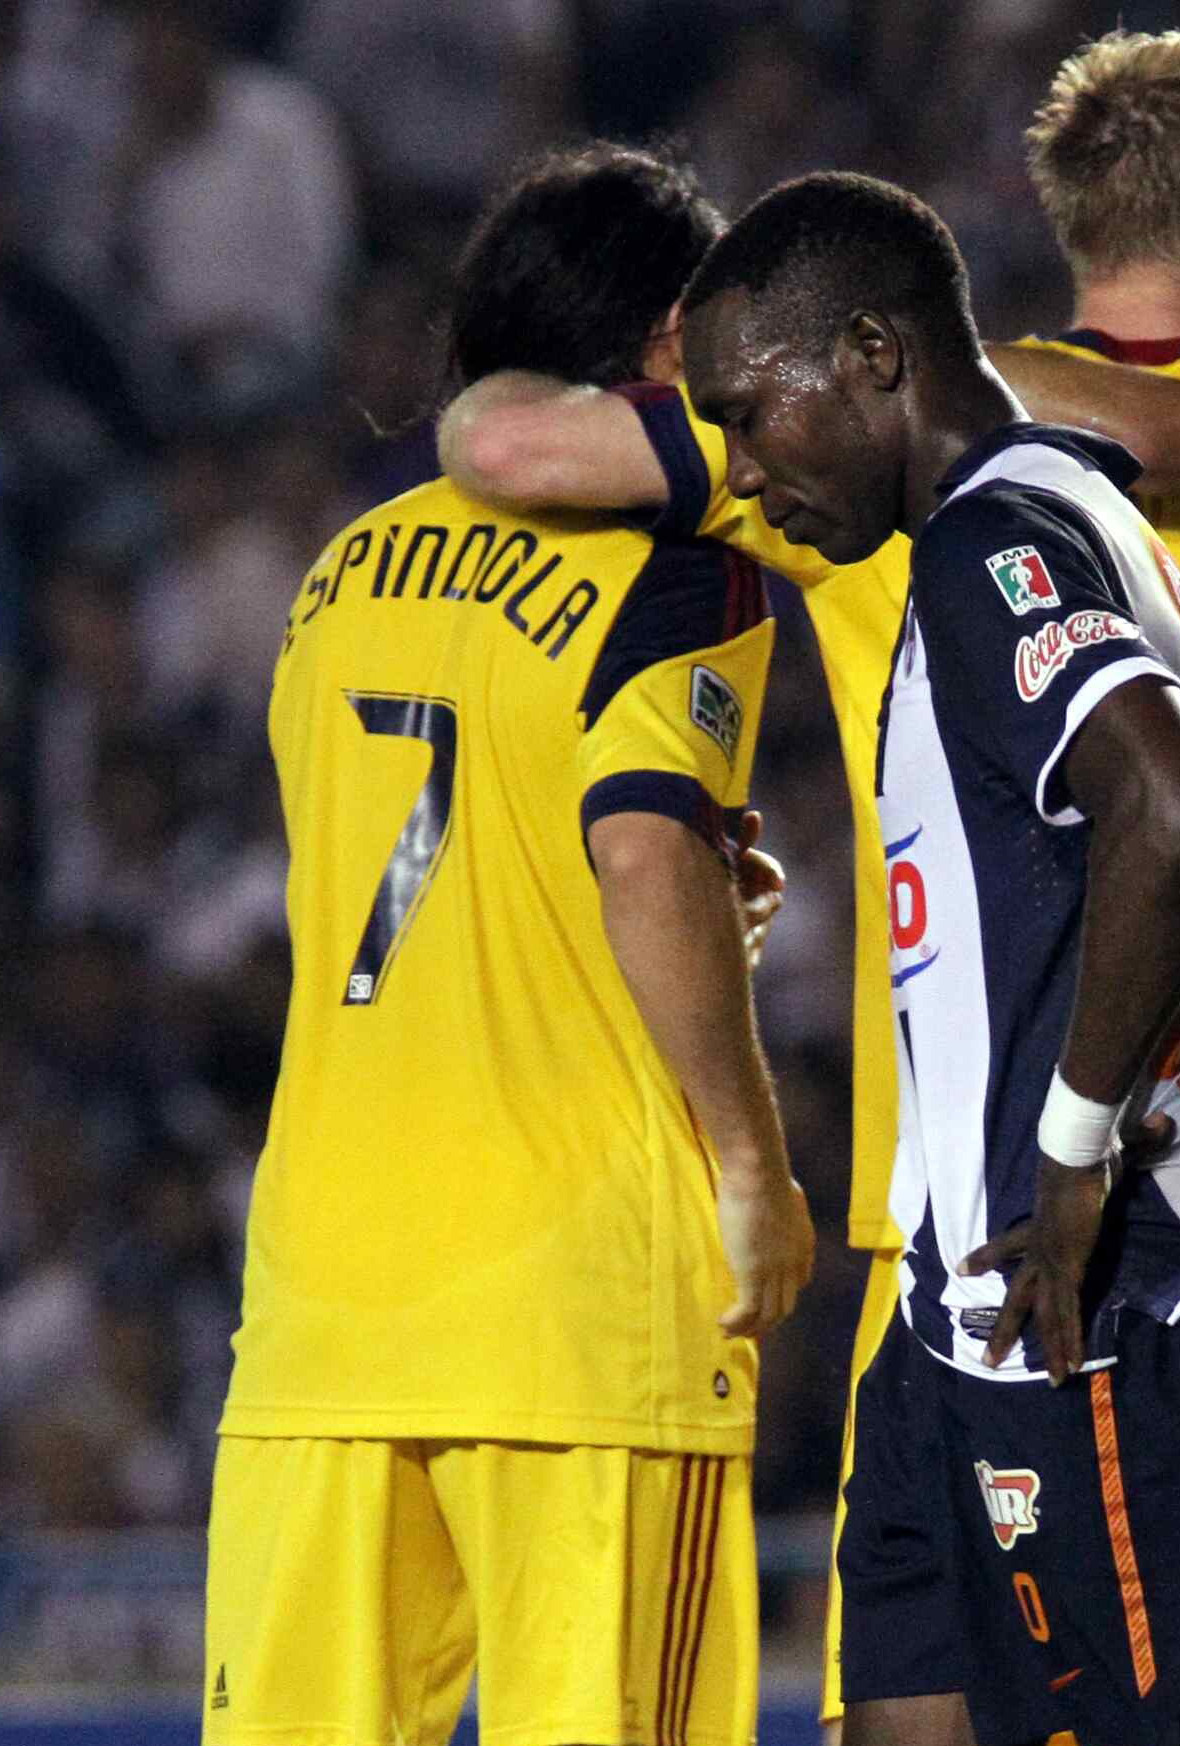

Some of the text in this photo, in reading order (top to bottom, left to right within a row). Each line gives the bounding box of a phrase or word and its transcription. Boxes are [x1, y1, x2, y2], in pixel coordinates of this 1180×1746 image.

[285, 524, 599, 661] SPINDOLA
[1066, 611, 1128, 645] Col
[339, 687, 458, 1006] 7
